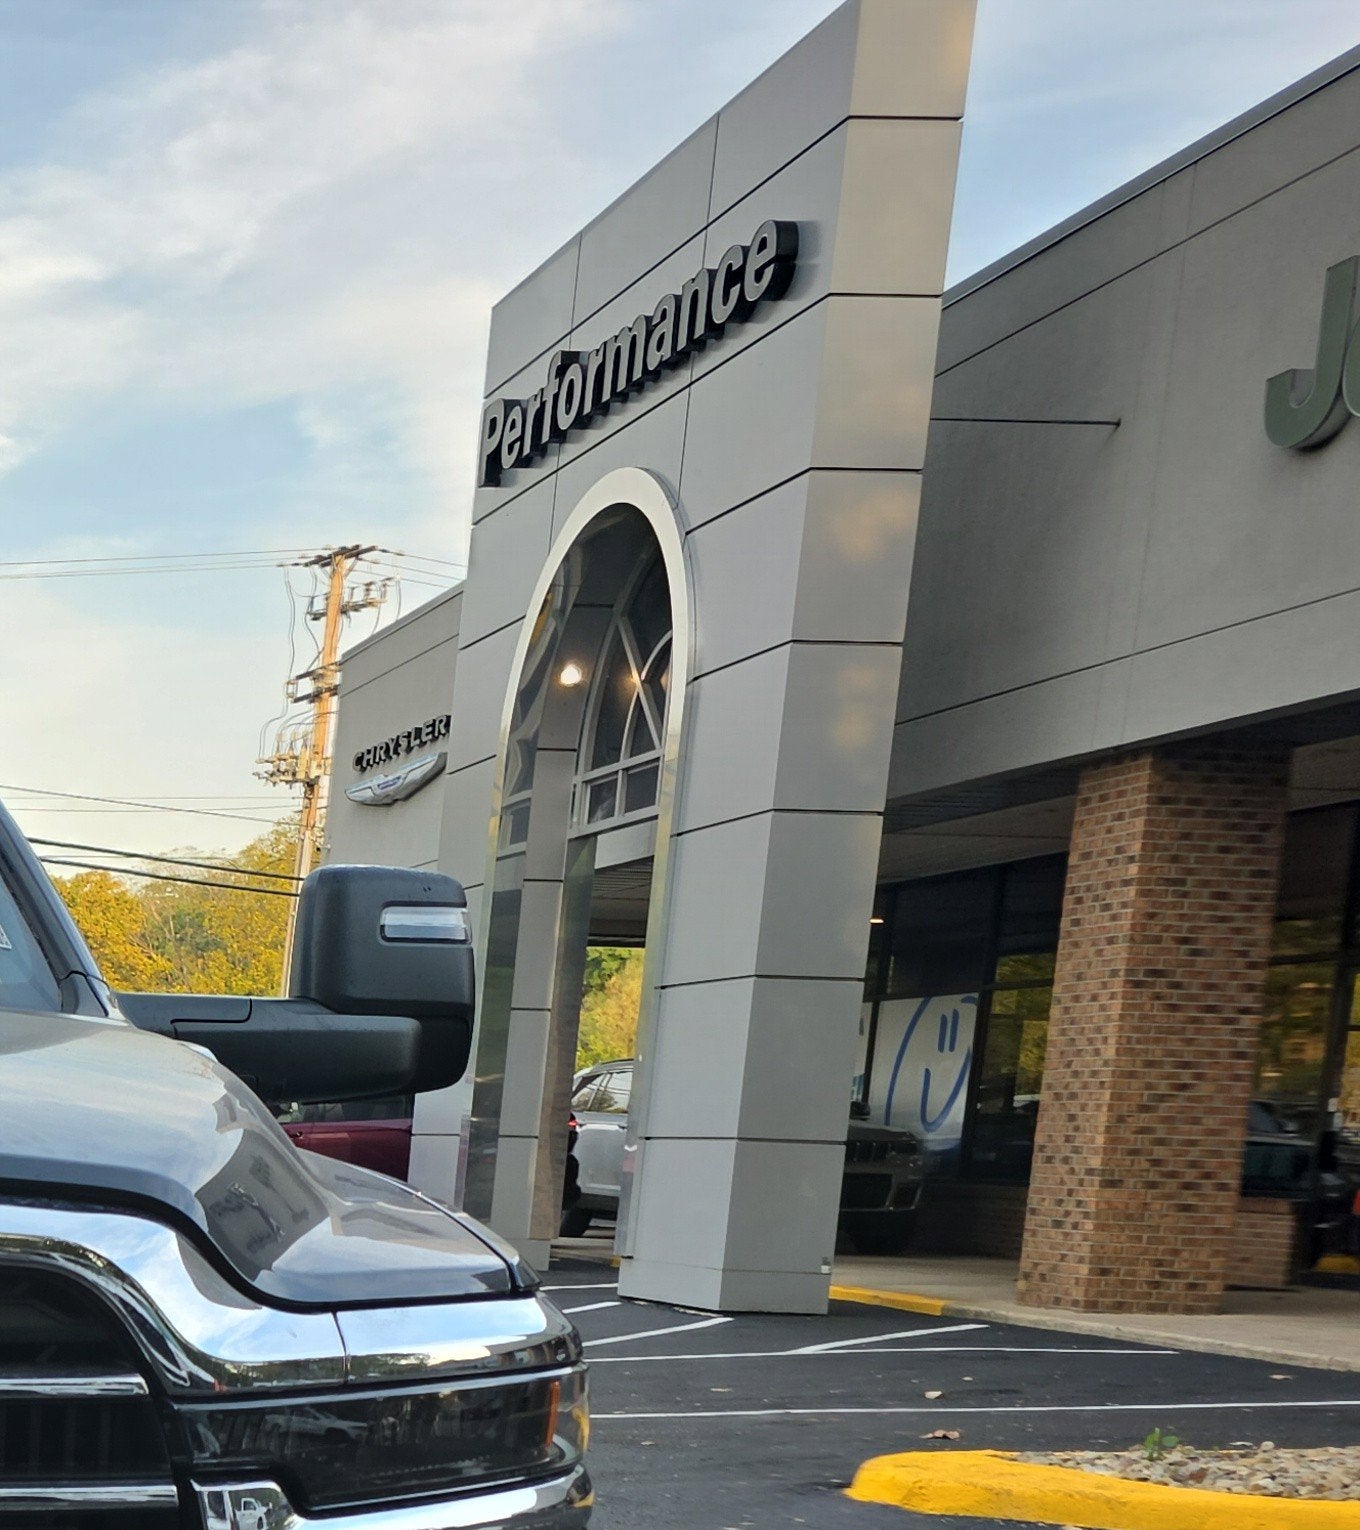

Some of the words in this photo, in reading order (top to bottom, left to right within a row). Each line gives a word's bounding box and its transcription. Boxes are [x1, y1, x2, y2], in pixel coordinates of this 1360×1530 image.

[478, 219, 794, 487] Performance
[1263, 254, 1360, 449] J
[352, 714, 451, 772] CHRYSLER
